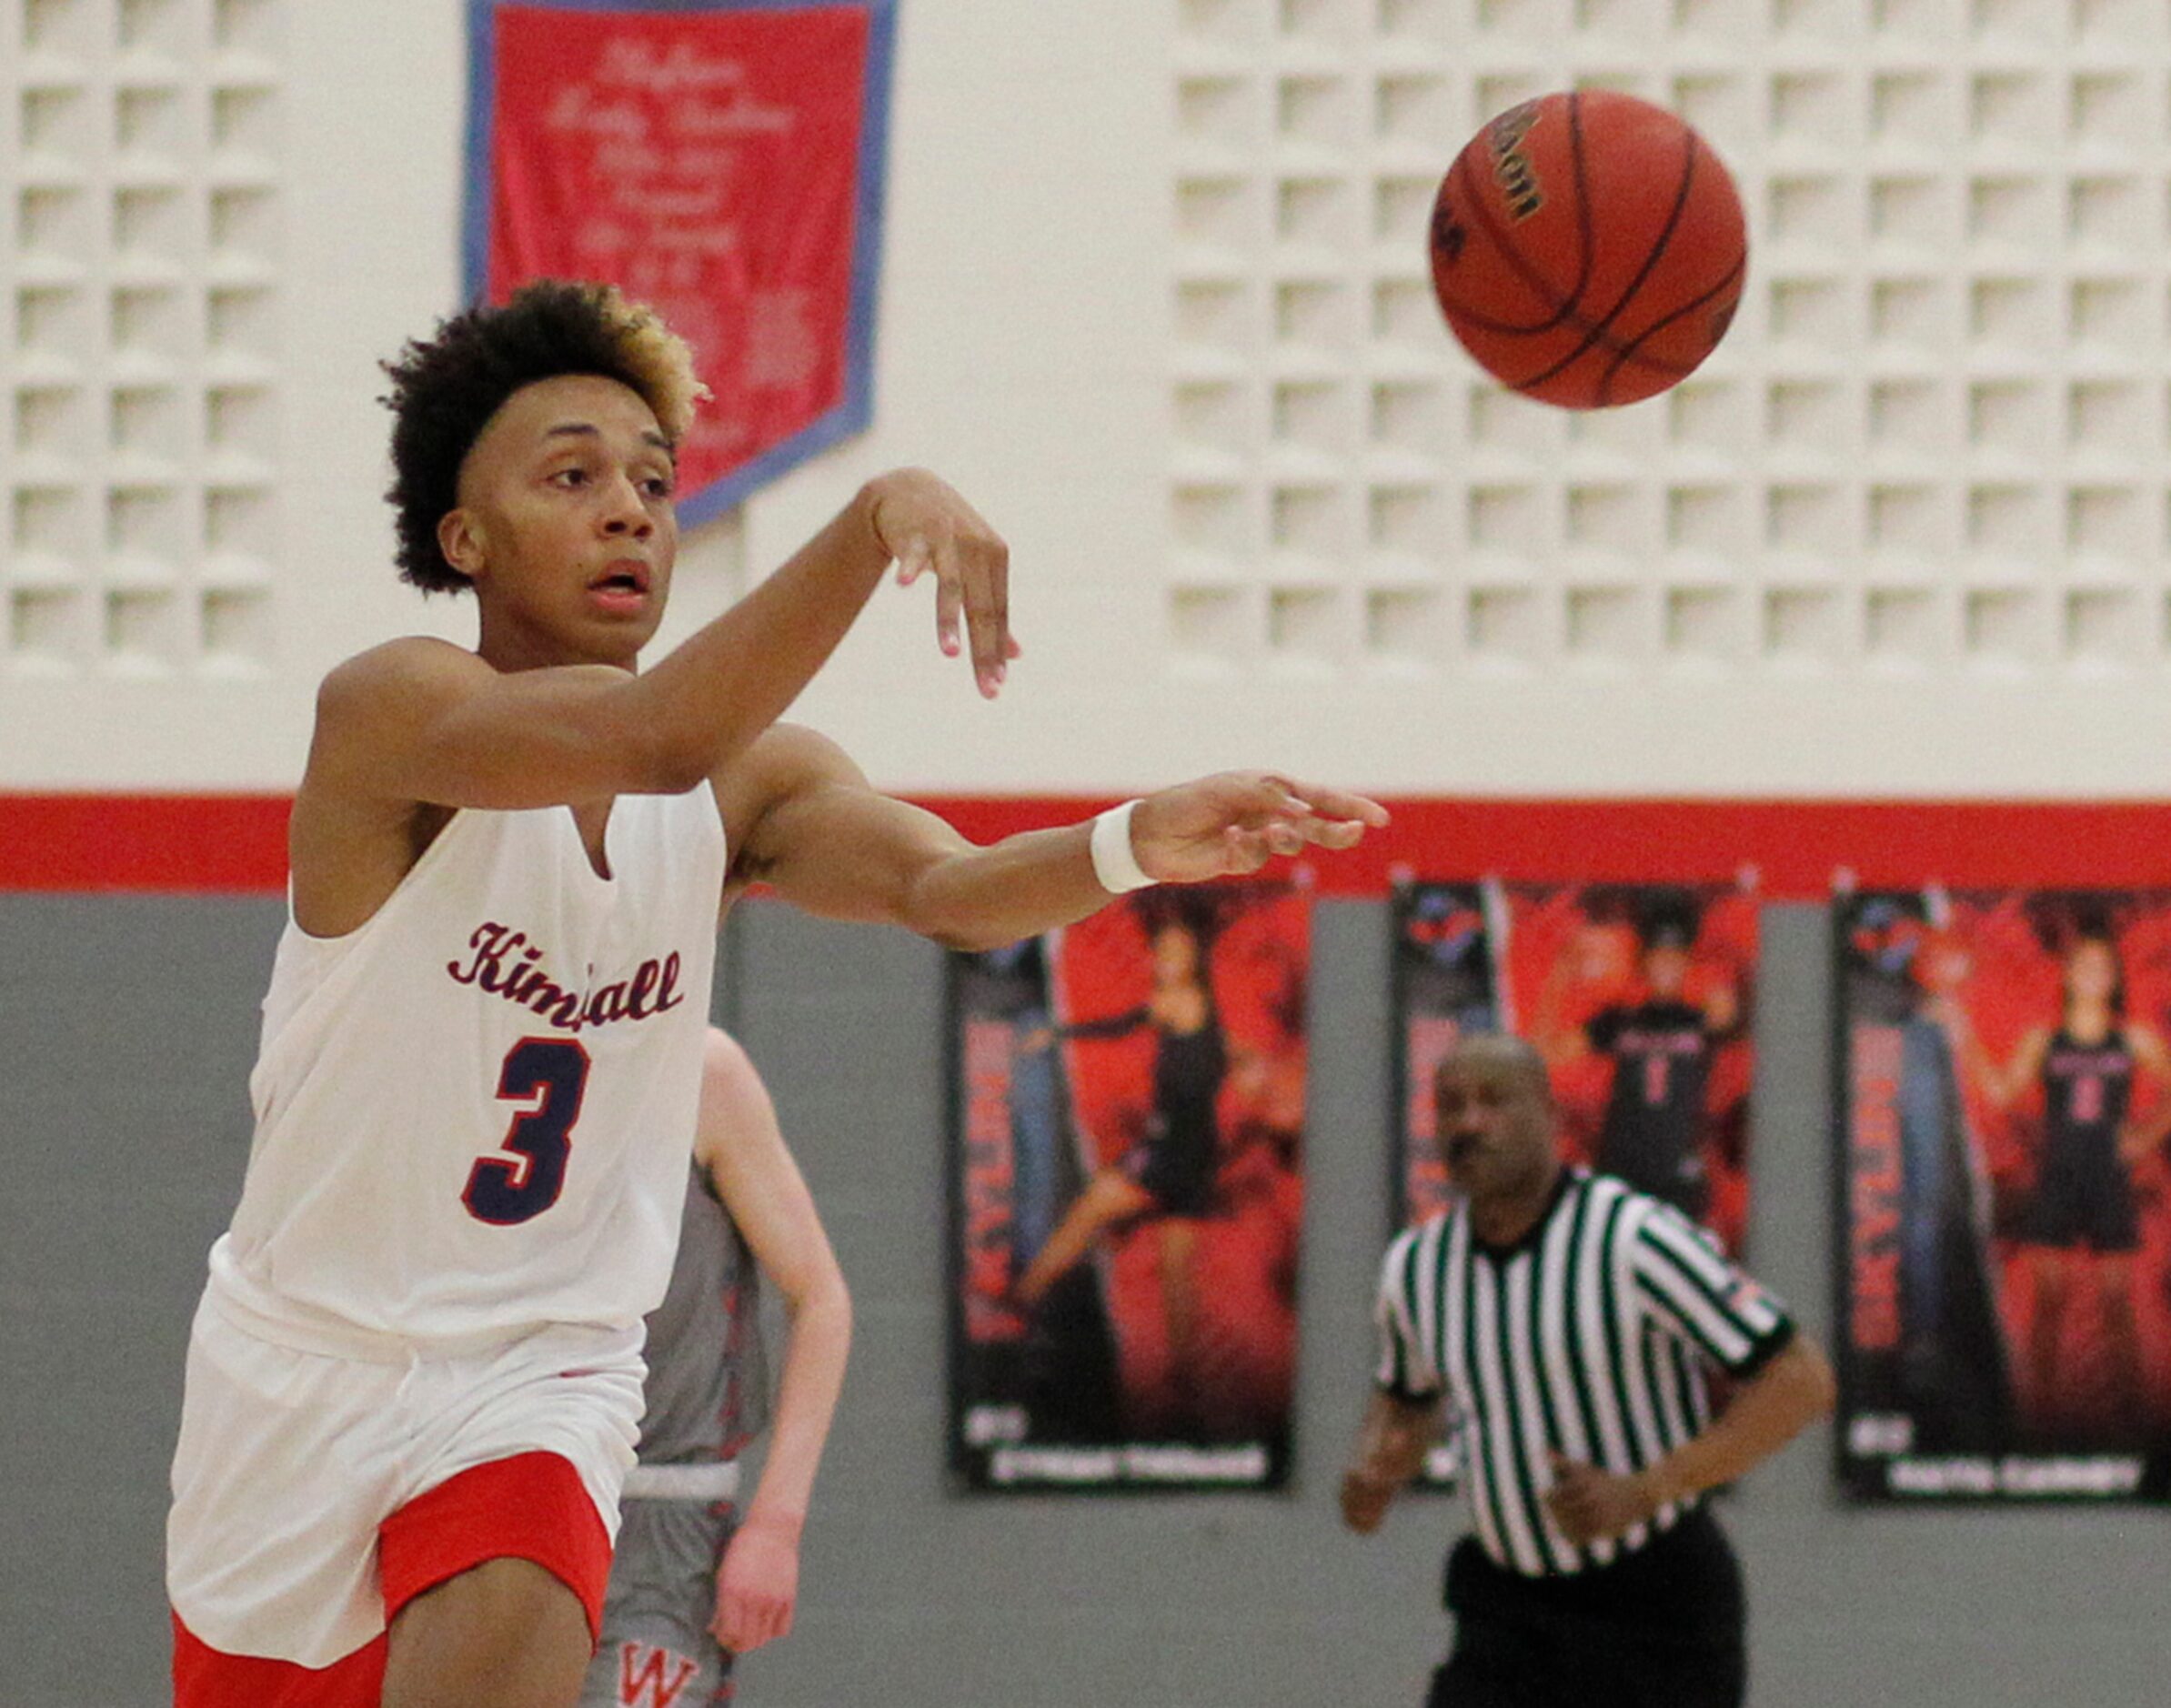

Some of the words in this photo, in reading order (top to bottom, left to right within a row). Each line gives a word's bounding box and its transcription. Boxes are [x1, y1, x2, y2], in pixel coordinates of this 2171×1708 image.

[447, 921, 684, 1033] Kimall
[460, 1036, 592, 1226] 3
[618, 1639, 702, 1708] W
